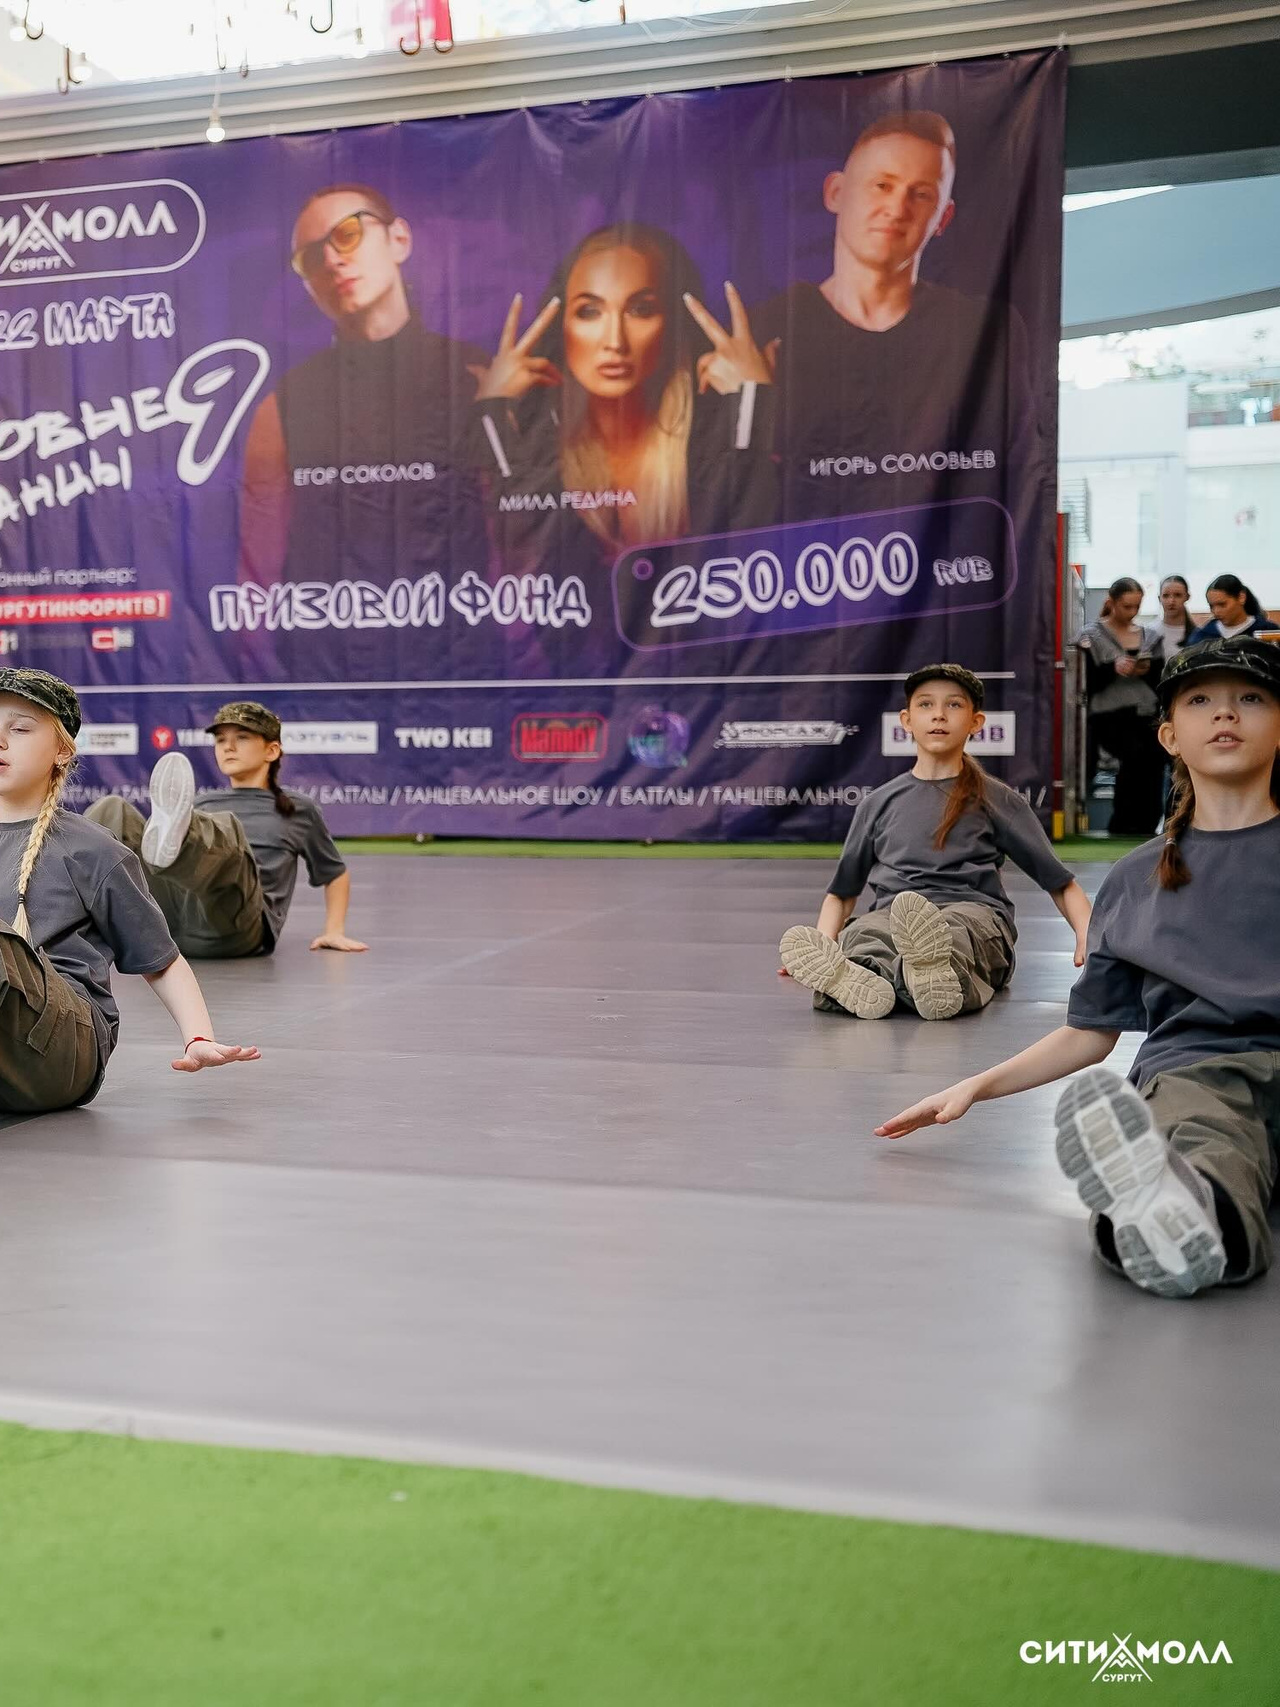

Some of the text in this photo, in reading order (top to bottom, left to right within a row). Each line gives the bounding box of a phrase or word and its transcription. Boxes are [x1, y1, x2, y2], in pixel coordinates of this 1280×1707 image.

[52, 200, 179, 243] МОЛЛ
[9, 256, 63, 273] СУРГУТ
[44, 292, 176, 347] МАРТА
[294, 462, 436, 486] ЕГОР СОКОЛОВ
[809, 449, 996, 477] ИГОРЬ СОЛОВЬЕВ
[499, 489, 638, 512] МИЛА РЕДИНА
[650, 531, 919, 628] 250.000
[209, 570, 592, 632] ПРИЗОВОЙ ФОНД
[394, 727, 493, 748] TWO KEI
[320, 785, 388, 805] БАТТЛЫ
[404, 785, 550, 806] ТАНЦЕВАЛЬНОЕ
[552, 785, 604, 806] ШОУ
[620, 785, 694, 806] БАТТЛЫ
